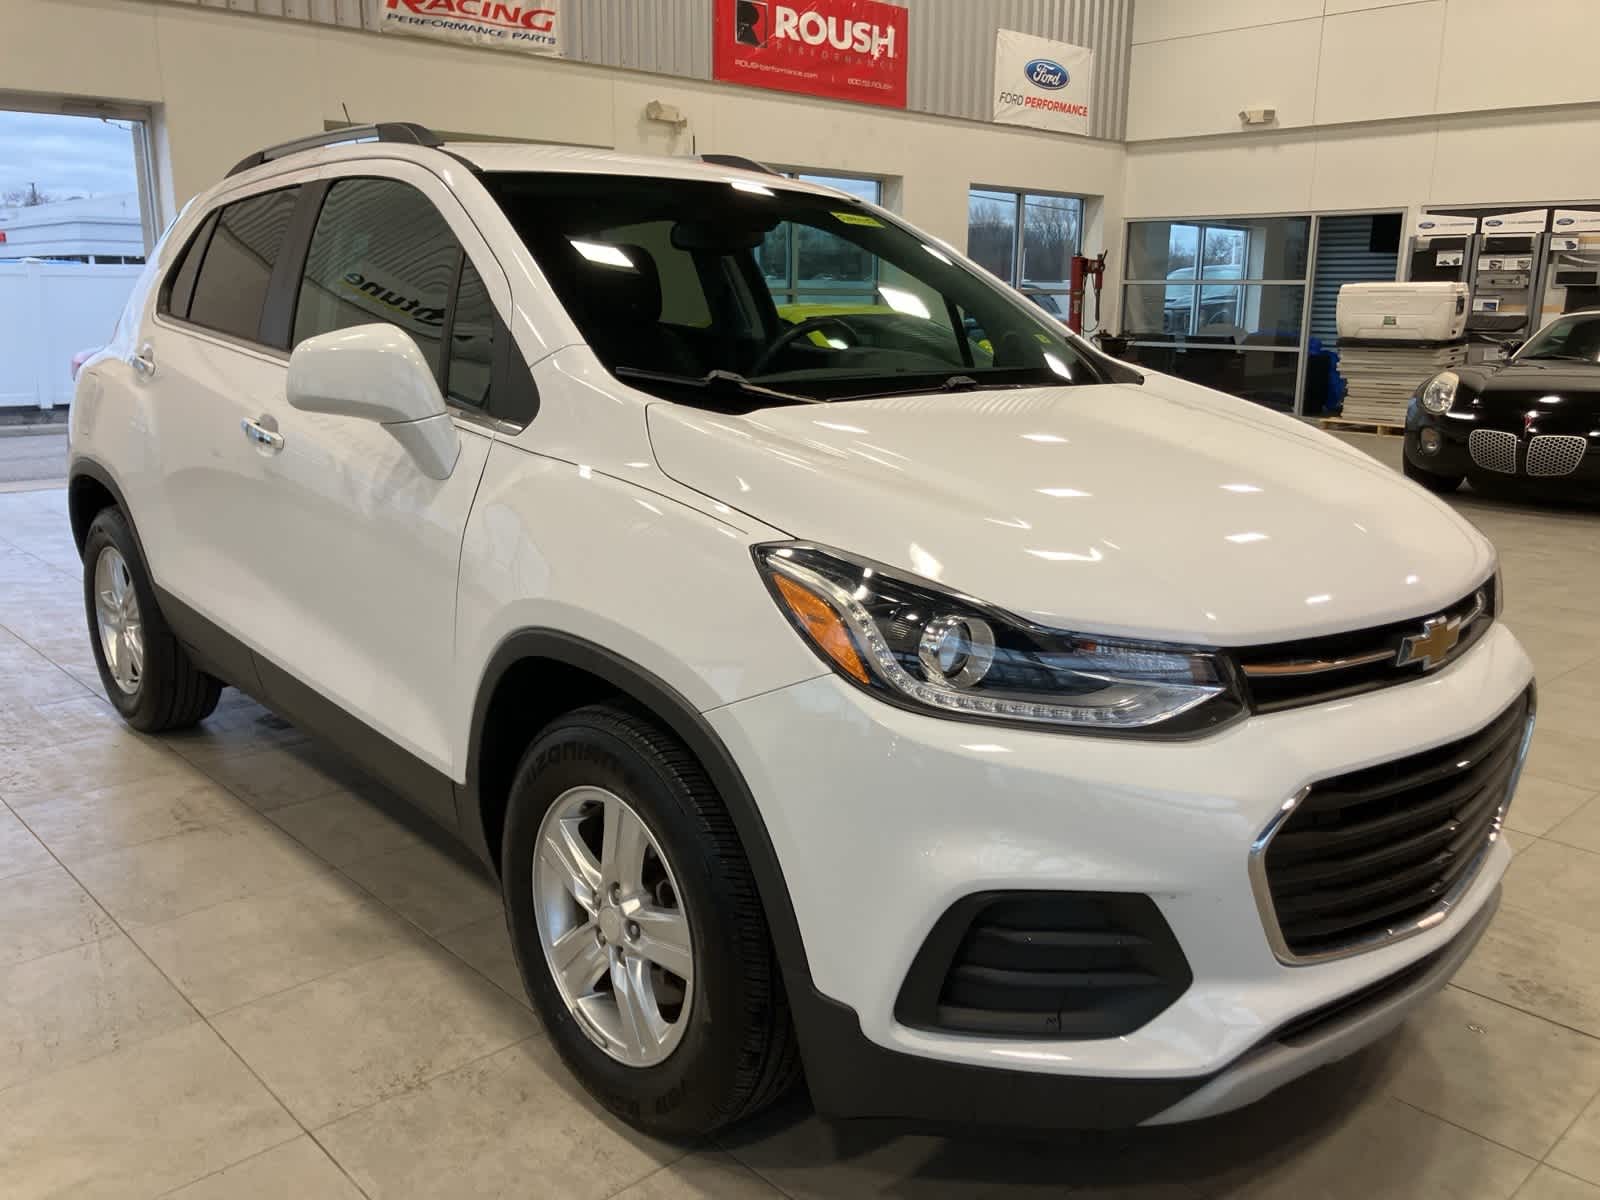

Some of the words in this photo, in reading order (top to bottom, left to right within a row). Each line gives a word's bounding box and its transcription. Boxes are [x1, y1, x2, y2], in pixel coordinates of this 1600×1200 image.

[387, 12, 505, 39] PERFORMANCE
[511, 31, 557, 45] PARTS
[775, 5, 896, 59] ROUSH
[1032, 63, 1061, 86] Ford
[998, 91, 1024, 106] FORD
[1024, 96, 1088, 117] PERFORMANCE
